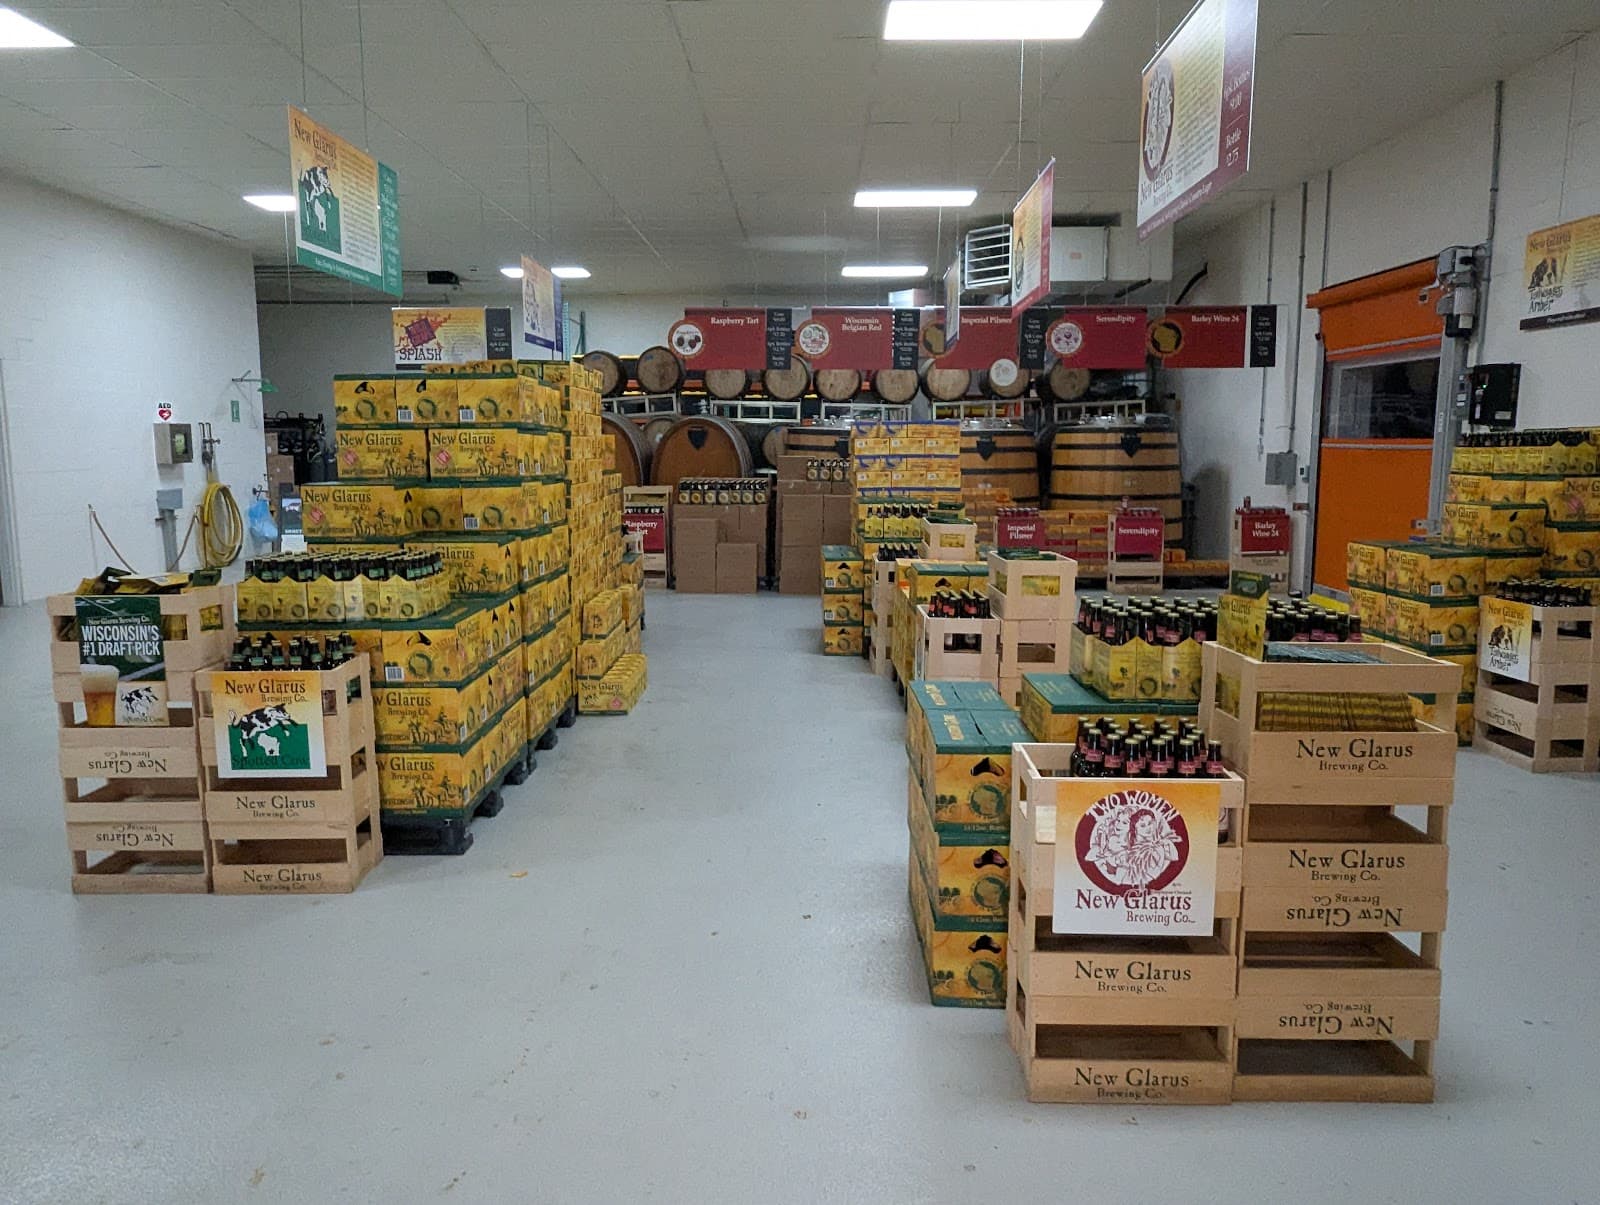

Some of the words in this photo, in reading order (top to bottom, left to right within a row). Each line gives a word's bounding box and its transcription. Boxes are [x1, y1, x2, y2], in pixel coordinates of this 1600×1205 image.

[294, 117, 312, 145] New
[312, 129, 337, 160] Glarus
[710, 317, 744, 327] Raspberry
[746, 317, 759, 325] Tart
[845, 317, 879, 325] Wisconsin
[961, 316, 989, 326] Imperial
[990, 316, 1013, 324] Pilsner
[1096, 315, 1136, 324] Serendipity
[1191, 315, 1212, 324] Barley
[841, 324, 868, 332] Belgian
[399, 348, 442, 360] SPLASH
[340, 433, 363, 446] New
[365, 433, 403, 446] Glarus
[432, 432, 455, 445] New
[458, 431, 496, 445] Glarus
[1567, 481, 1589, 492] New
[304, 489, 330, 502] New
[332, 489, 372, 502] Glarus
[1007, 523, 1036, 533] Imperial
[1118, 527, 1159, 536] Serendipity
[1254, 521, 1276, 529] Barley
[1009, 531, 1033, 540] Pilsner
[437, 546, 475, 560] Glarus
[1488, 603, 1501, 615] New
[1502, 606, 1525, 620] Glarus
[100, 617, 119, 625] Glarus
[119, 616, 141, 625] Brewing
[81, 625, 160, 641] WISCONSIN'S
[82, 641, 97, 656] #1
[98, 641, 133, 656] DRAFT
[134, 641, 160, 656] PICK
[225, 679, 256, 695] New
[258, 679, 306, 695] Glarus
[261, 694, 293, 704] Brewing
[294, 694, 308, 703] Co.
[386, 691, 432, 706] Glarus
[119, 750, 150, 758] Brewing
[1296, 738, 1342, 758] New
[1349, 737, 1413, 758] Glarus
[88, 759, 132, 774] Glarus
[137, 758, 168, 773] New
[231, 754, 278, 769] Spotted
[281, 755, 311, 767] Cow
[390, 756, 435, 771] Glarus
[1318, 760, 1364, 773] Brewing
[1367, 759, 1388, 771] Co.
[236, 797, 267, 809] New
[271, 796, 316, 809] Glarus
[1085, 792, 1121, 819] TWO
[1123, 790, 1180, 822] WOMEN
[252, 810, 284, 819] Brewing
[285, 810, 300, 818] Co.
[95, 833, 140, 847] Glarus
[144, 832, 174, 846] New
[1289, 849, 1334, 868] New
[1341, 849, 1406, 869] Glarus
[243, 869, 274, 883] New
[277, 868, 322, 882] Glarus
[1311, 871, 1357, 883] Brewing
[1359, 870, 1381, 881] Co.
[258, 883, 290, 892] Brewing
[1075, 888, 1120, 910] New
[1124, 889, 1192, 911] Glarus
[1311, 895, 1332, 906] Co.
[1335, 893, 1381, 906] Brewing
[1126, 910, 1171, 927] Brewing
[1286, 908, 1351, 927] Glarus
[1357, 907, 1403, 927] New
[1074, 960, 1120, 980] New
[1127, 960, 1192, 981] Glarus
[1097, 981, 1144, 994] Brewing
[1146, 981, 1168, 993] Co.
[1303, 1003, 1324, 1014] Co.
[1327, 1001, 1372, 1014] Brewing
[1279, 1016, 1343, 1035] Glarus
[1350, 1016, 1395, 1036] New
[1074, 1067, 1119, 1086] New
[1125, 1067, 1190, 1087] Glarus
[1097, 1087, 1144, 1100] Brewing
[1145, 1088, 1166, 1099] Co.
